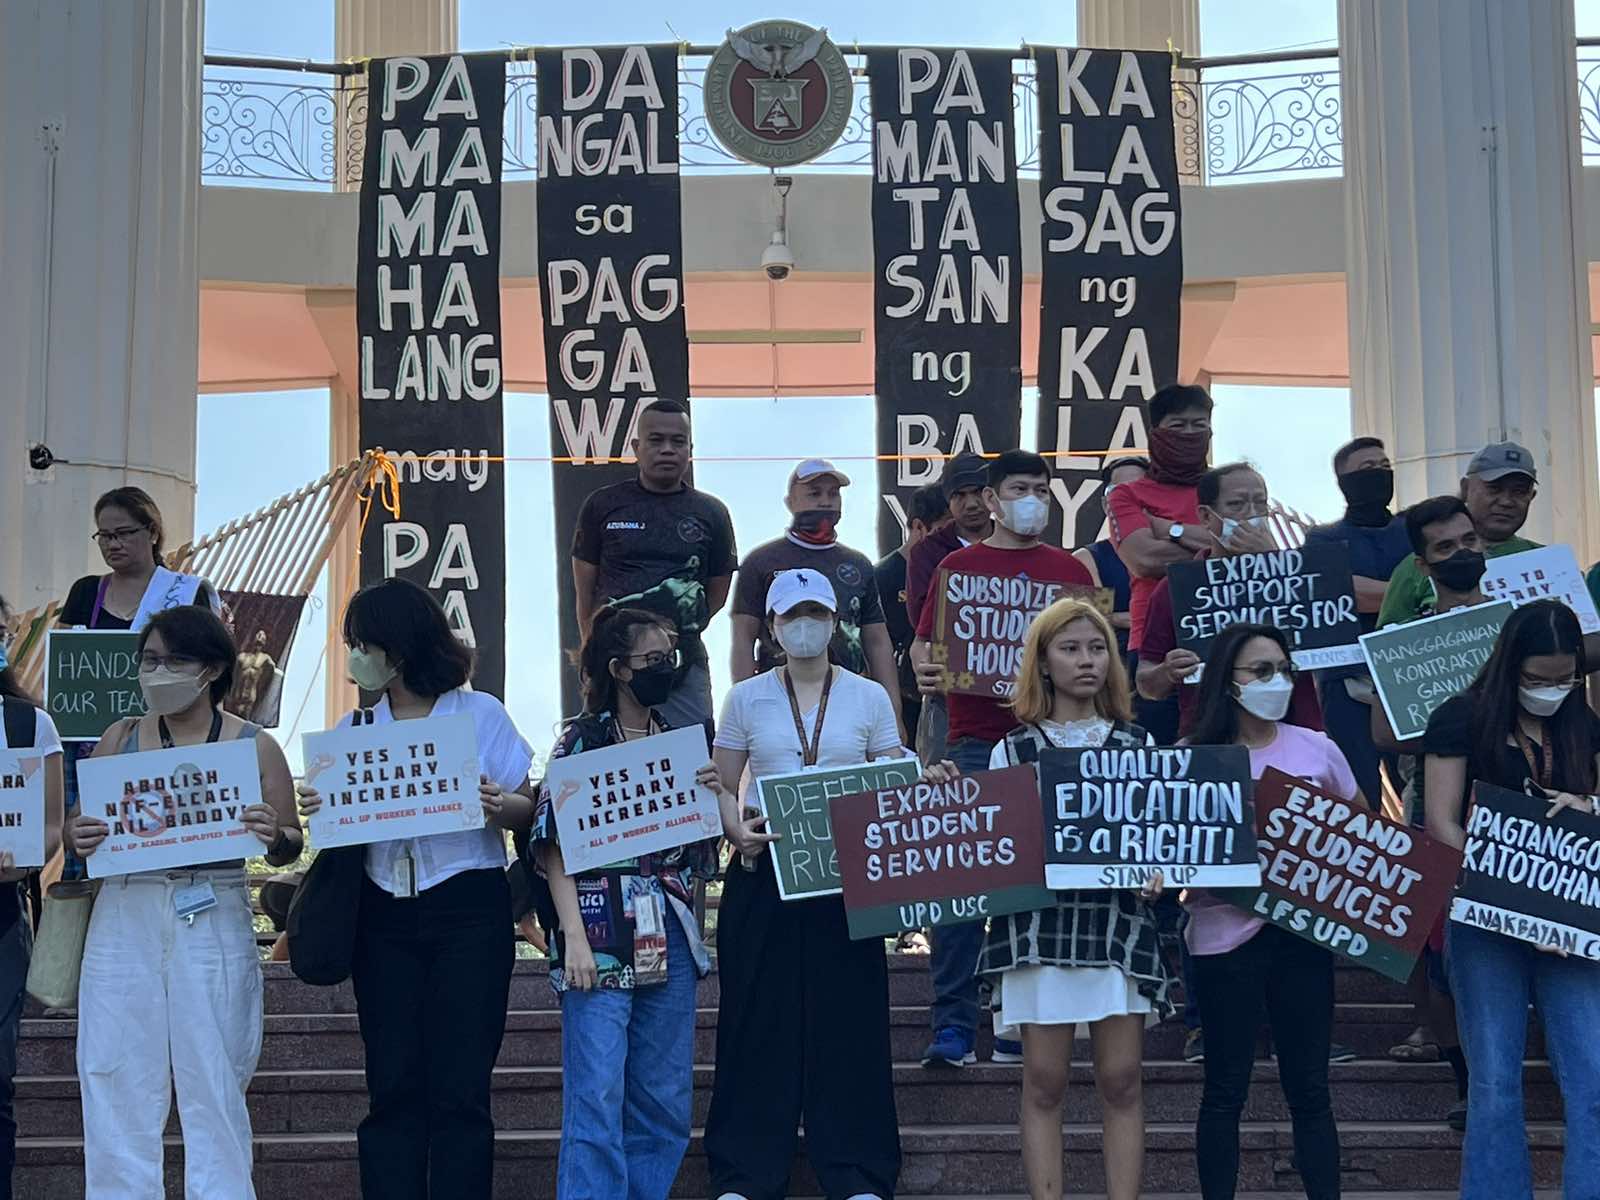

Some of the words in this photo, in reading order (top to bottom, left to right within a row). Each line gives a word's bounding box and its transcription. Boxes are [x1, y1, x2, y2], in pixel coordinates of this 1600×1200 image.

[381, 55, 479, 121] PA
[561, 46, 665, 111] DA
[898, 48, 986, 115] PA
[1056, 48, 1155, 118] KA
[379, 127, 492, 188] MA
[538, 112, 680, 178] NGAL
[876, 120, 1005, 184] MAN
[1060, 123, 1160, 189] LA
[376, 190, 489, 258] MA
[575, 203, 633, 234] sa
[893, 187, 981, 251] TA
[1044, 187, 1176, 256] SAG
[379, 262, 480, 331] HA
[547, 254, 679, 326] PAG
[885, 254, 1010, 325] SAN
[1080, 275, 1137, 317] ng
[361, 333, 500, 401] LANG
[559, 327, 657, 393] GA
[912, 351, 971, 397] ng
[1058, 327, 1156, 400] KA
[1055, 405, 1151, 470] LA
[375, 447, 489, 492] may
[383, 522, 479, 590] PA
[1205, 549, 1304, 585] EXPAND
[947, 573, 1063, 610] SUBSIDIZE
[1192, 573, 1321, 611] SUPPORT
[1312, 595, 1359, 629] FOR
[52, 690, 97, 714] OUR
[346, 749, 389, 766] YES
[408, 743, 435, 758] TO
[347, 761, 438, 785] SALARY
[589, 768, 629, 789] YES
[646, 758, 672, 775] TO
[105, 786, 240, 817] NTF-ELCAC!
[124, 770, 218, 795] ABOLISH
[330, 777, 459, 807] INCREASE!
[578, 789, 697, 831] INCREASE!
[592, 775, 675, 808] SALARY
[877, 776, 981, 819] EXPAND
[864, 805, 1001, 849] STUDENT
[1285, 786, 1412, 857] EXPAND
[866, 836, 1016, 881] SERVICES
[1170, 866, 1198, 884] UP
[1265, 807, 1423, 896] STUDENT
[900, 902, 942, 928] UPD
[952, 895, 989, 918] USC
[1256, 839, 1413, 938] SERVICES
[1254, 892, 1312, 932] LFS
[1312, 916, 1369, 956] UPD
[1463, 904, 1578, 953] ANAKBAYAN
